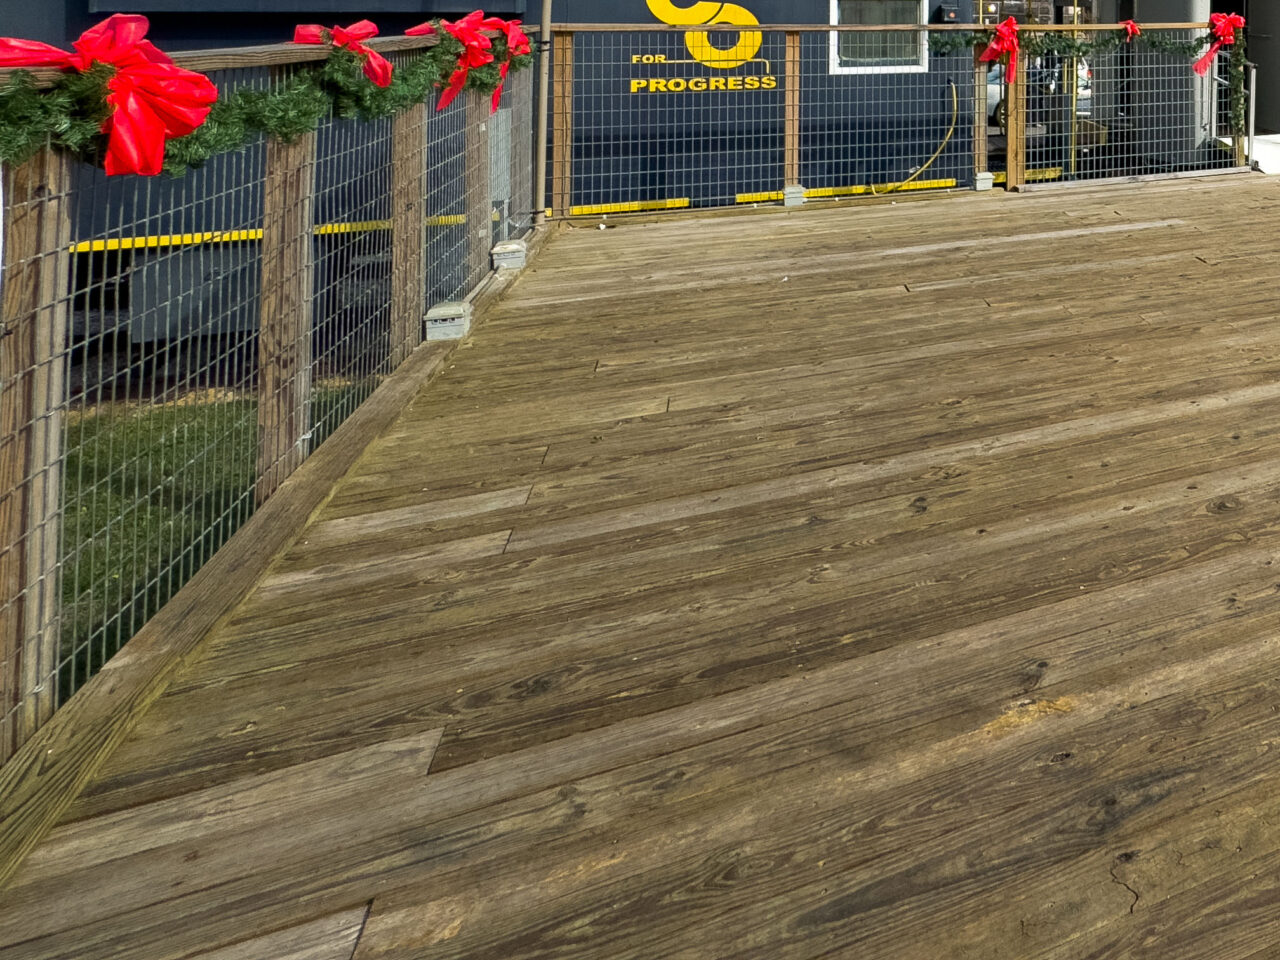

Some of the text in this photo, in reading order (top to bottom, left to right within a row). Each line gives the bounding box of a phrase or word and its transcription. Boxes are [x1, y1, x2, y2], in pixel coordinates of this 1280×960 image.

[684, 2, 763, 69] O
[631, 54, 667, 64] FOR
[630, 75, 777, 93] PROGRESS
